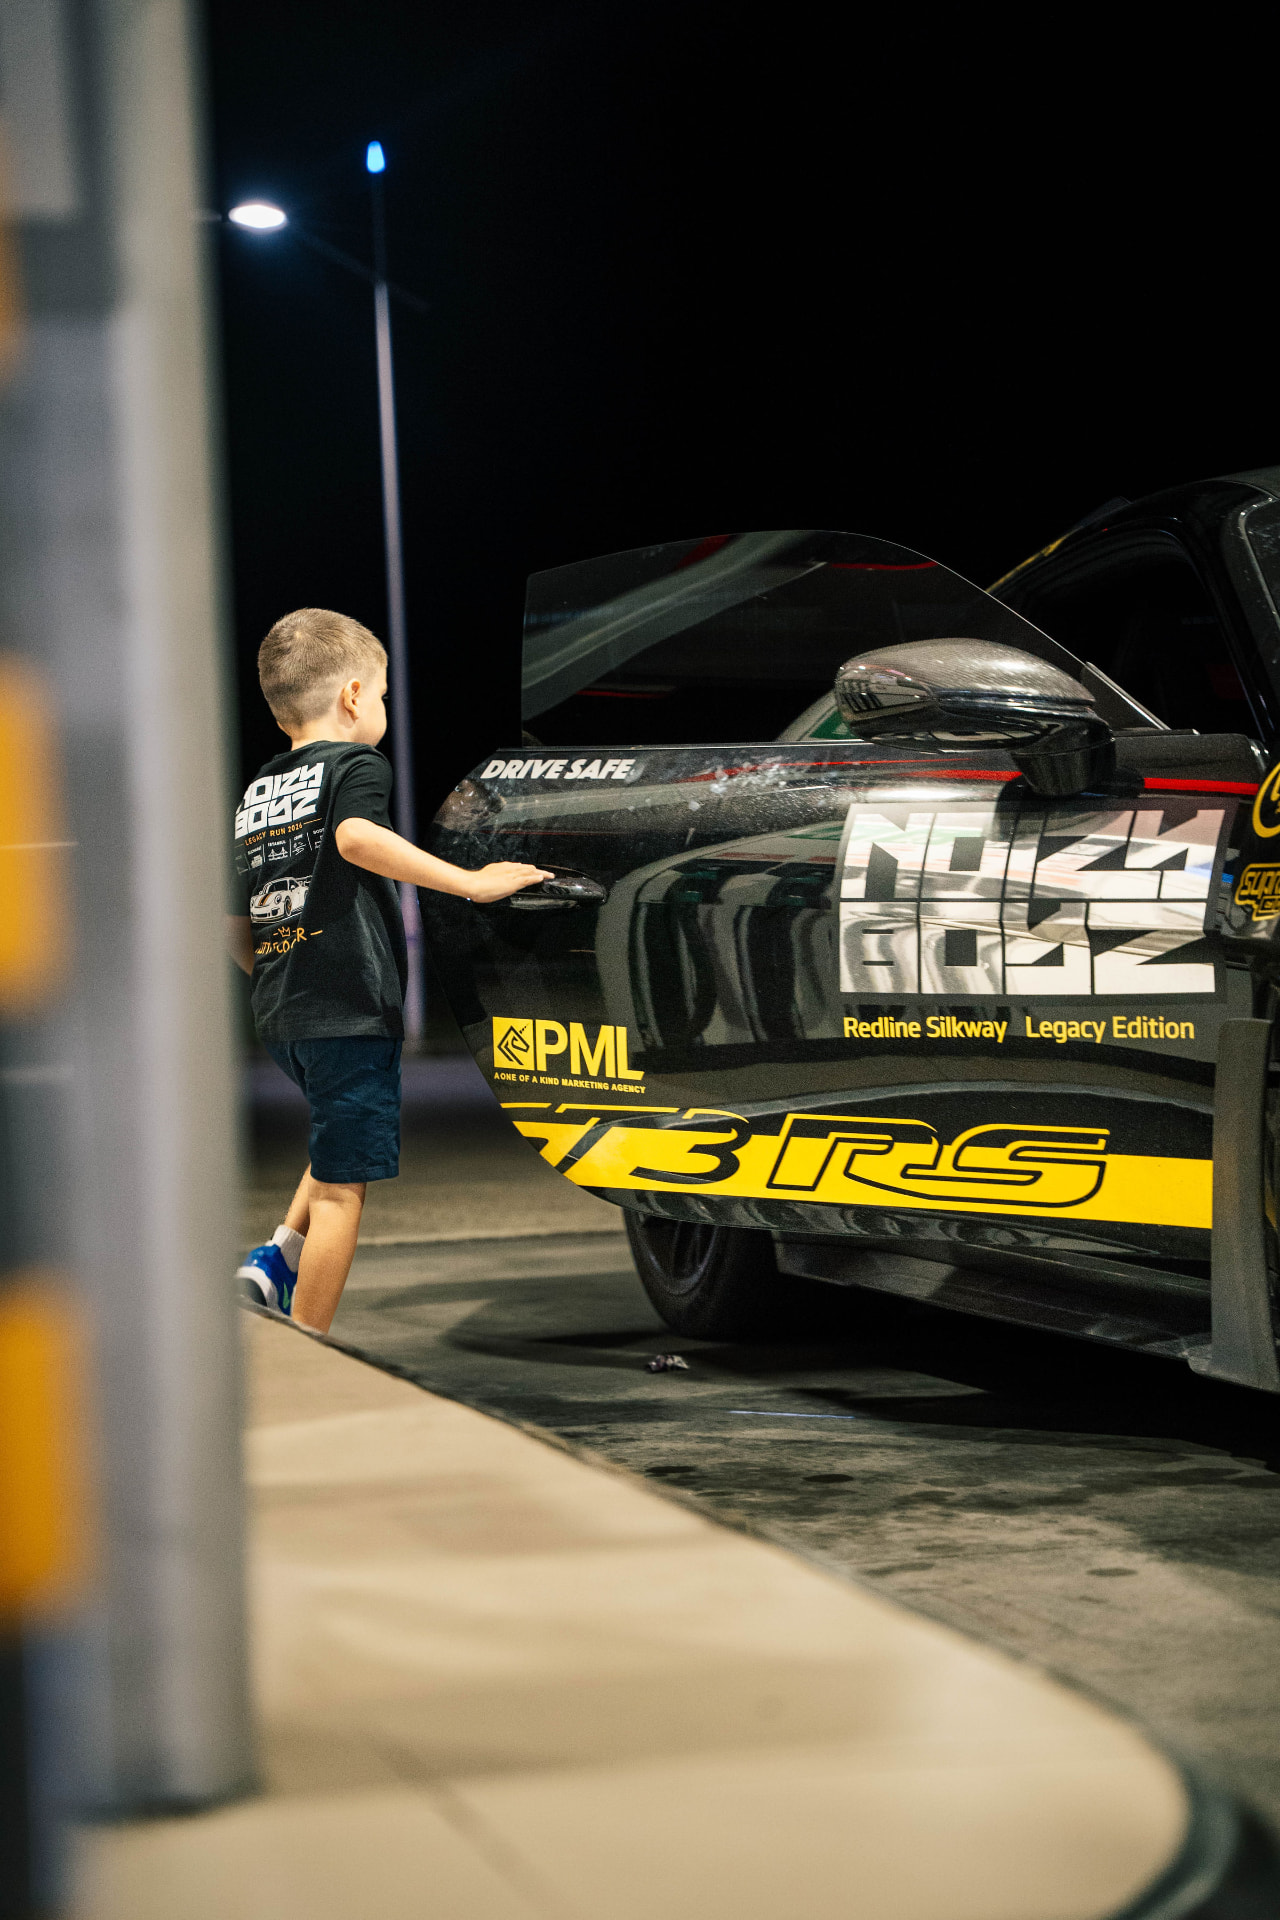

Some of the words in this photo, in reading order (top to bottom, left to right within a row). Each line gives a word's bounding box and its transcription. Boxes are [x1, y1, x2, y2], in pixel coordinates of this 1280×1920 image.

[480, 759, 569, 780] DRIVE
[564, 759, 636, 780] SAFE
[245, 831, 267, 846] LEGACY
[269, 828, 286, 837] RUN
[840, 901, 1216, 995] BOYZ
[843, 1016, 922, 1039] Redline
[926, 1016, 1008, 1043] Silkway
[1025, 1016, 1107, 1044] Legacy
[1112, 1016, 1195, 1040] Edition
[535, 1019, 645, 1081] PML
[519, 1074, 530, 1083] OF
[540, 1077, 560, 1086] KIND
[562, 1079, 609, 1091] MARKETING
[611, 1084, 646, 1094] AGENCY
